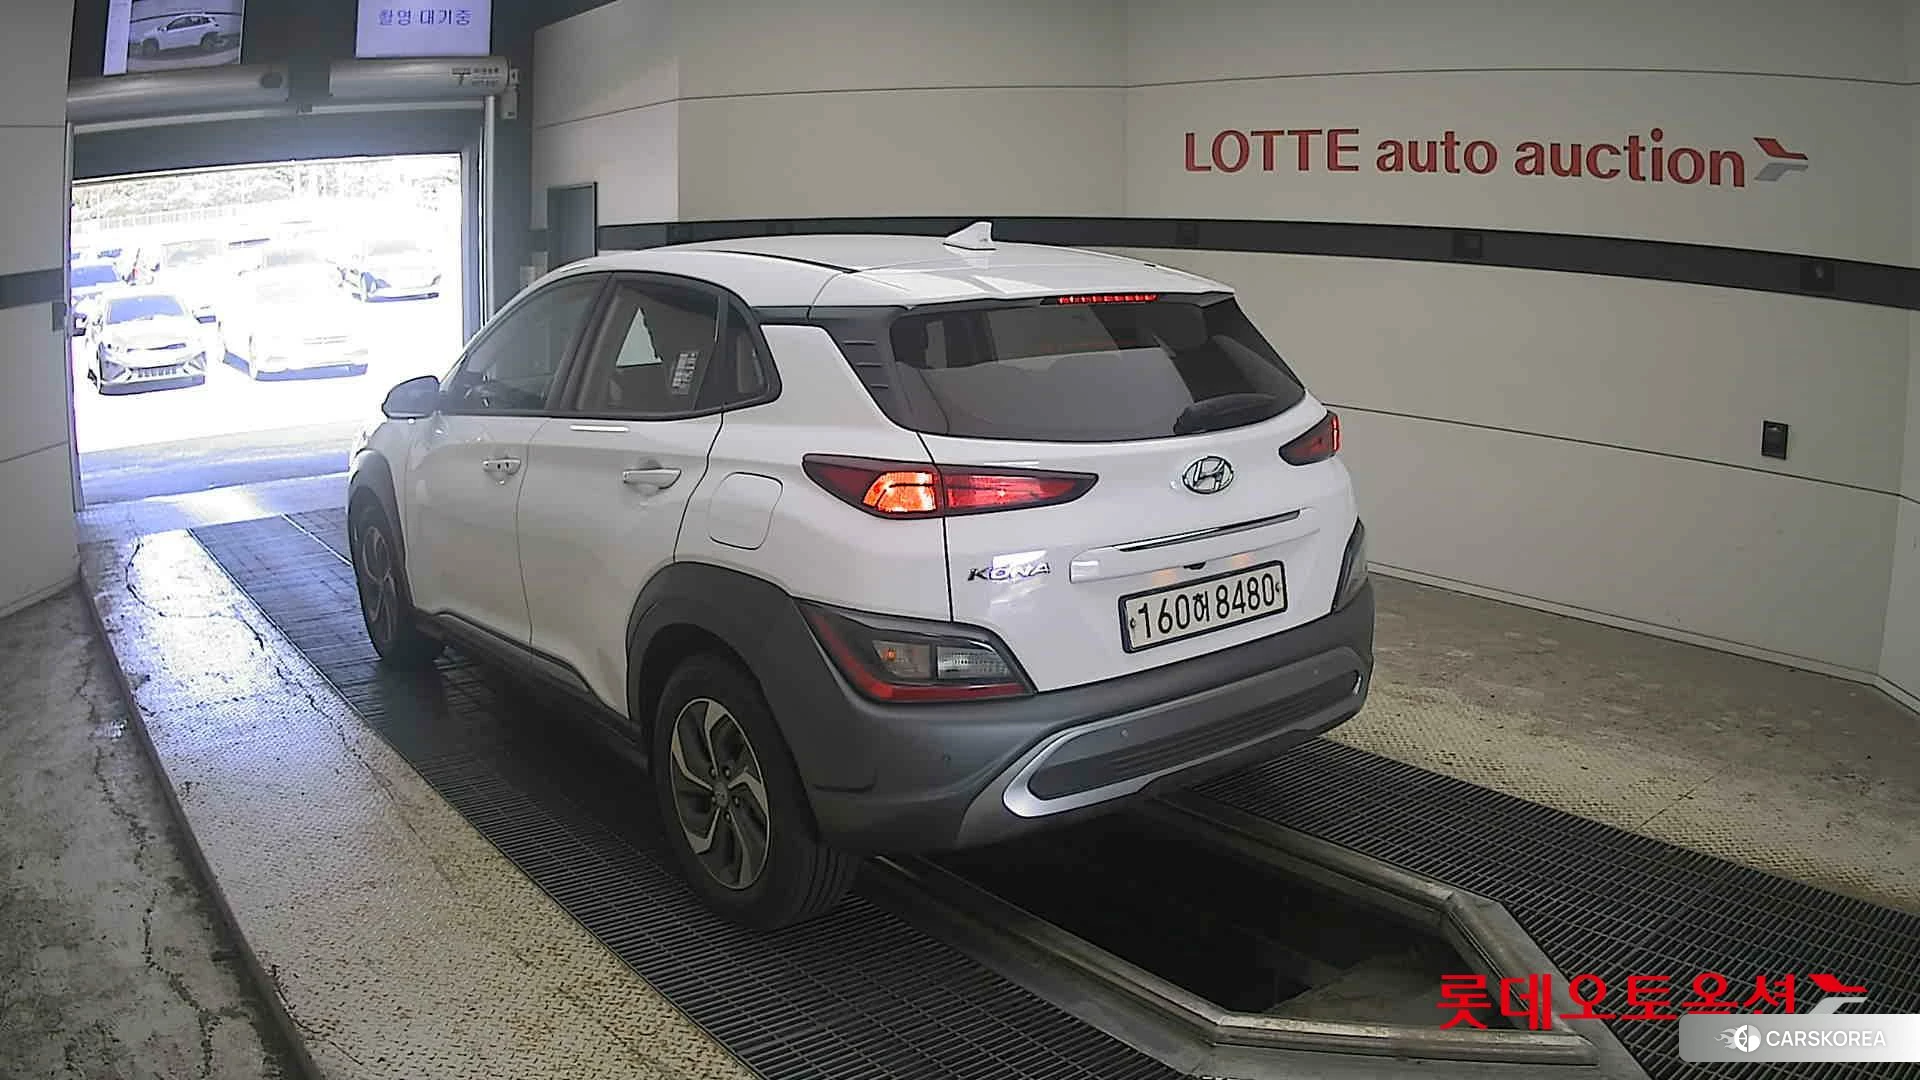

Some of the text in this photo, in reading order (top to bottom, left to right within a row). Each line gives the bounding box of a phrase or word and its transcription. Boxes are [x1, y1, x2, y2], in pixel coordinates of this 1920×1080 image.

[420, 8, 472, 26] 대기중
[1185, 128, 1745, 187] LOTTE auto auction
